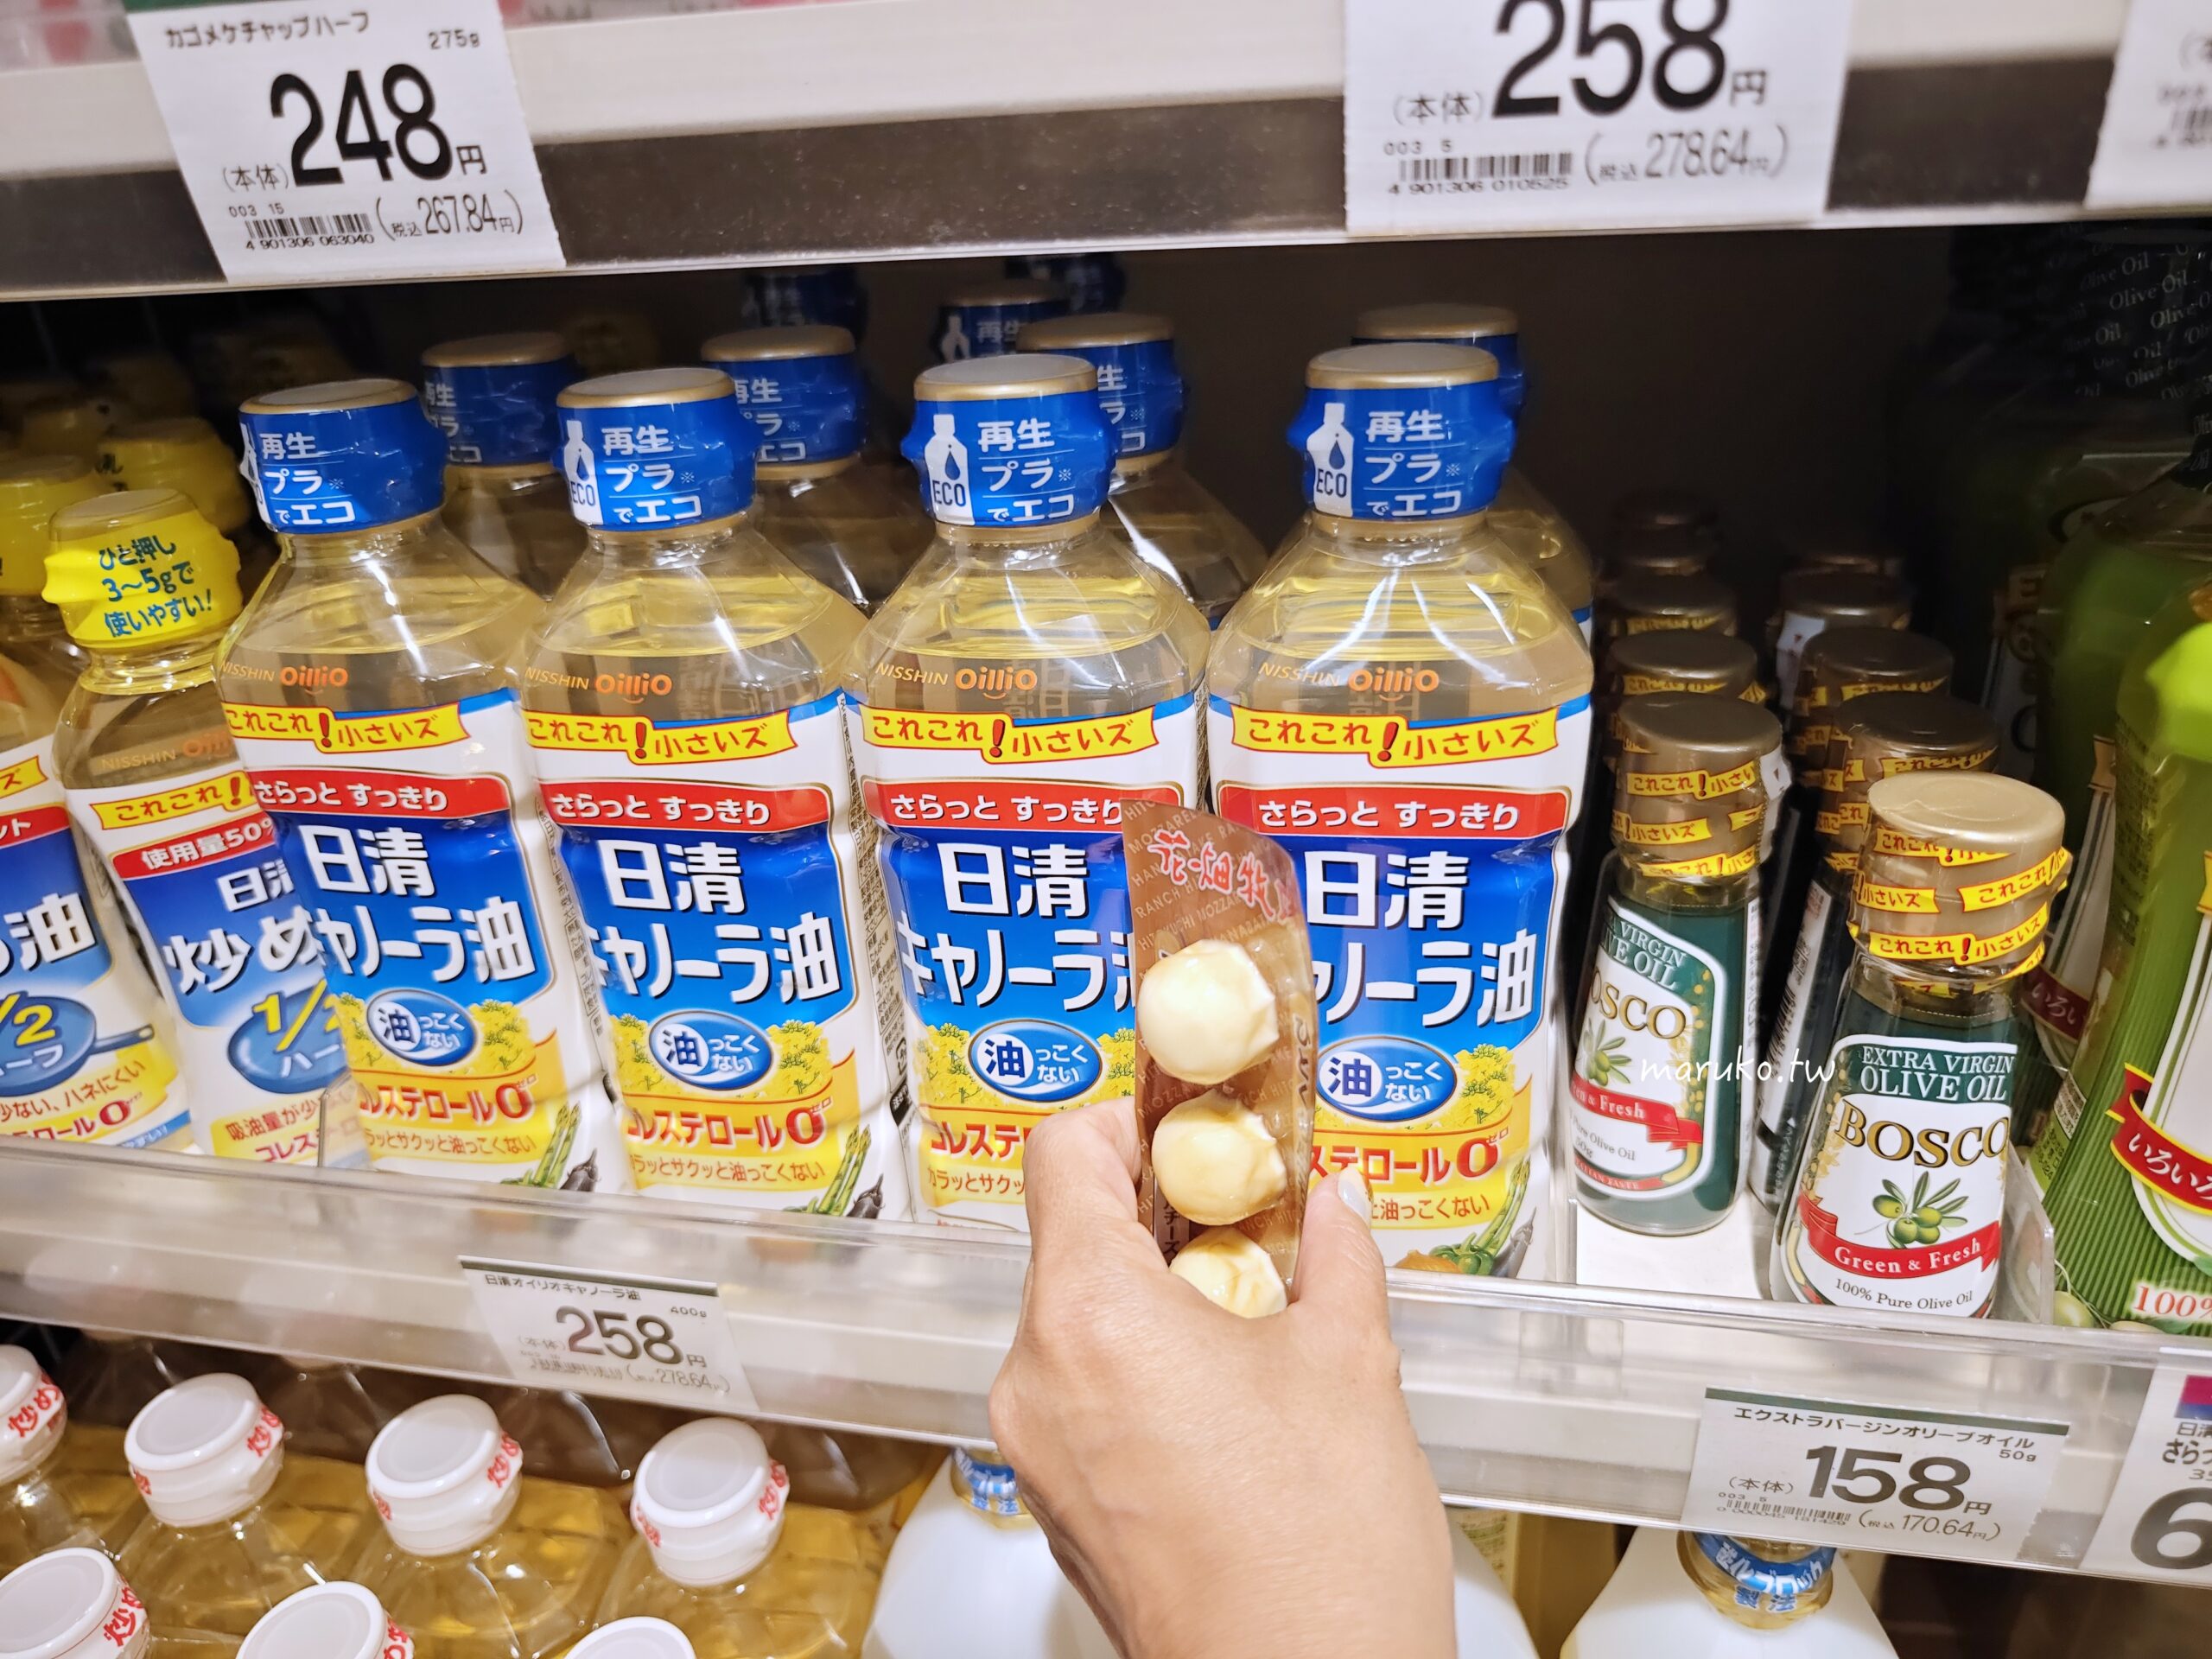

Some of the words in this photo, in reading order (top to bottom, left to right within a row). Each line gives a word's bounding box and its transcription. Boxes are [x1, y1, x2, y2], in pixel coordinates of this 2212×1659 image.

[165, 13, 369, 48] カゴメケチャップハーフ
[429, 31, 480, 49] 275g
[228, 205, 257, 217] 003
[2162, 270, 2187, 293] Oil
[601, 424, 674, 456] 再生
[977, 418, 1055, 452] 再生
[1366, 409, 1446, 443] 再生
[259, 432, 318, 461] 再生
[931, 479, 966, 507] ECO
[1315, 468, 1347, 499] ECO
[275, 500, 356, 524] でエコ
[613, 495, 702, 524] でエコ
[987, 493, 1075, 523] でエコ
[1366, 490, 1462, 516] でエコ
[98, 535, 176, 570] ひと押し
[525, 667, 589, 690] NISSHIN
[875, 664, 948, 685] NISSHIN
[1258, 662, 1340, 685] NISSHIN
[254, 781, 342, 805] さらっと
[346, 783, 448, 812] すっきり
[551, 793, 652, 819] さらっと
[658, 797, 772, 825] すっきり
[890, 795, 1001, 820] さらっと
[1260, 801, 1380, 827] さらっと
[1394, 801, 1519, 830] すっきり
[299, 825, 435, 897] 日清
[598, 842, 747, 915] 日清
[938, 842, 1089, 918] 日清
[1305, 851, 1469, 929] 日清
[1135, 888, 1181, 918] RANCH
[1620, 921, 1687, 967] VIRGIN
[1633, 954, 1677, 990] OIL
[1862, 1046, 1936, 1071] EXTRA
[1943, 1054, 2016, 1076] VIRGIN
[1860, 1066, 1961, 1103] OLIVE
[1967, 1073, 2008, 1103] OIL
[1599, 1094, 1645, 1119] Fresh
[365, 1130, 537, 1155] ラッとサクッと油っこくない
[931, 1122, 1032, 1159] コレステ
[1590, 1132, 1615, 1154] Olive
[1618, 1147, 1636, 1161] Oil
[1834, 1098, 2010, 1169] BOSCO
[1834, 1245, 1901, 1274] Green
[1928, 1237, 1981, 1269] Fresh
[1835, 1278, 1872, 1301] 100%
[1877, 1292, 1912, 1310] Pure
[1917, 1296, 1953, 1310] Olive
[1956, 1290, 1974, 1306] Oil
[671, 1306, 708, 1319] 400g
[1734, 1407, 2036, 1450] エクストラバージンオリーブオイル
[1999, 1448, 2037, 1463] 50g
[1728, 1476, 1795, 1495] (本体)
